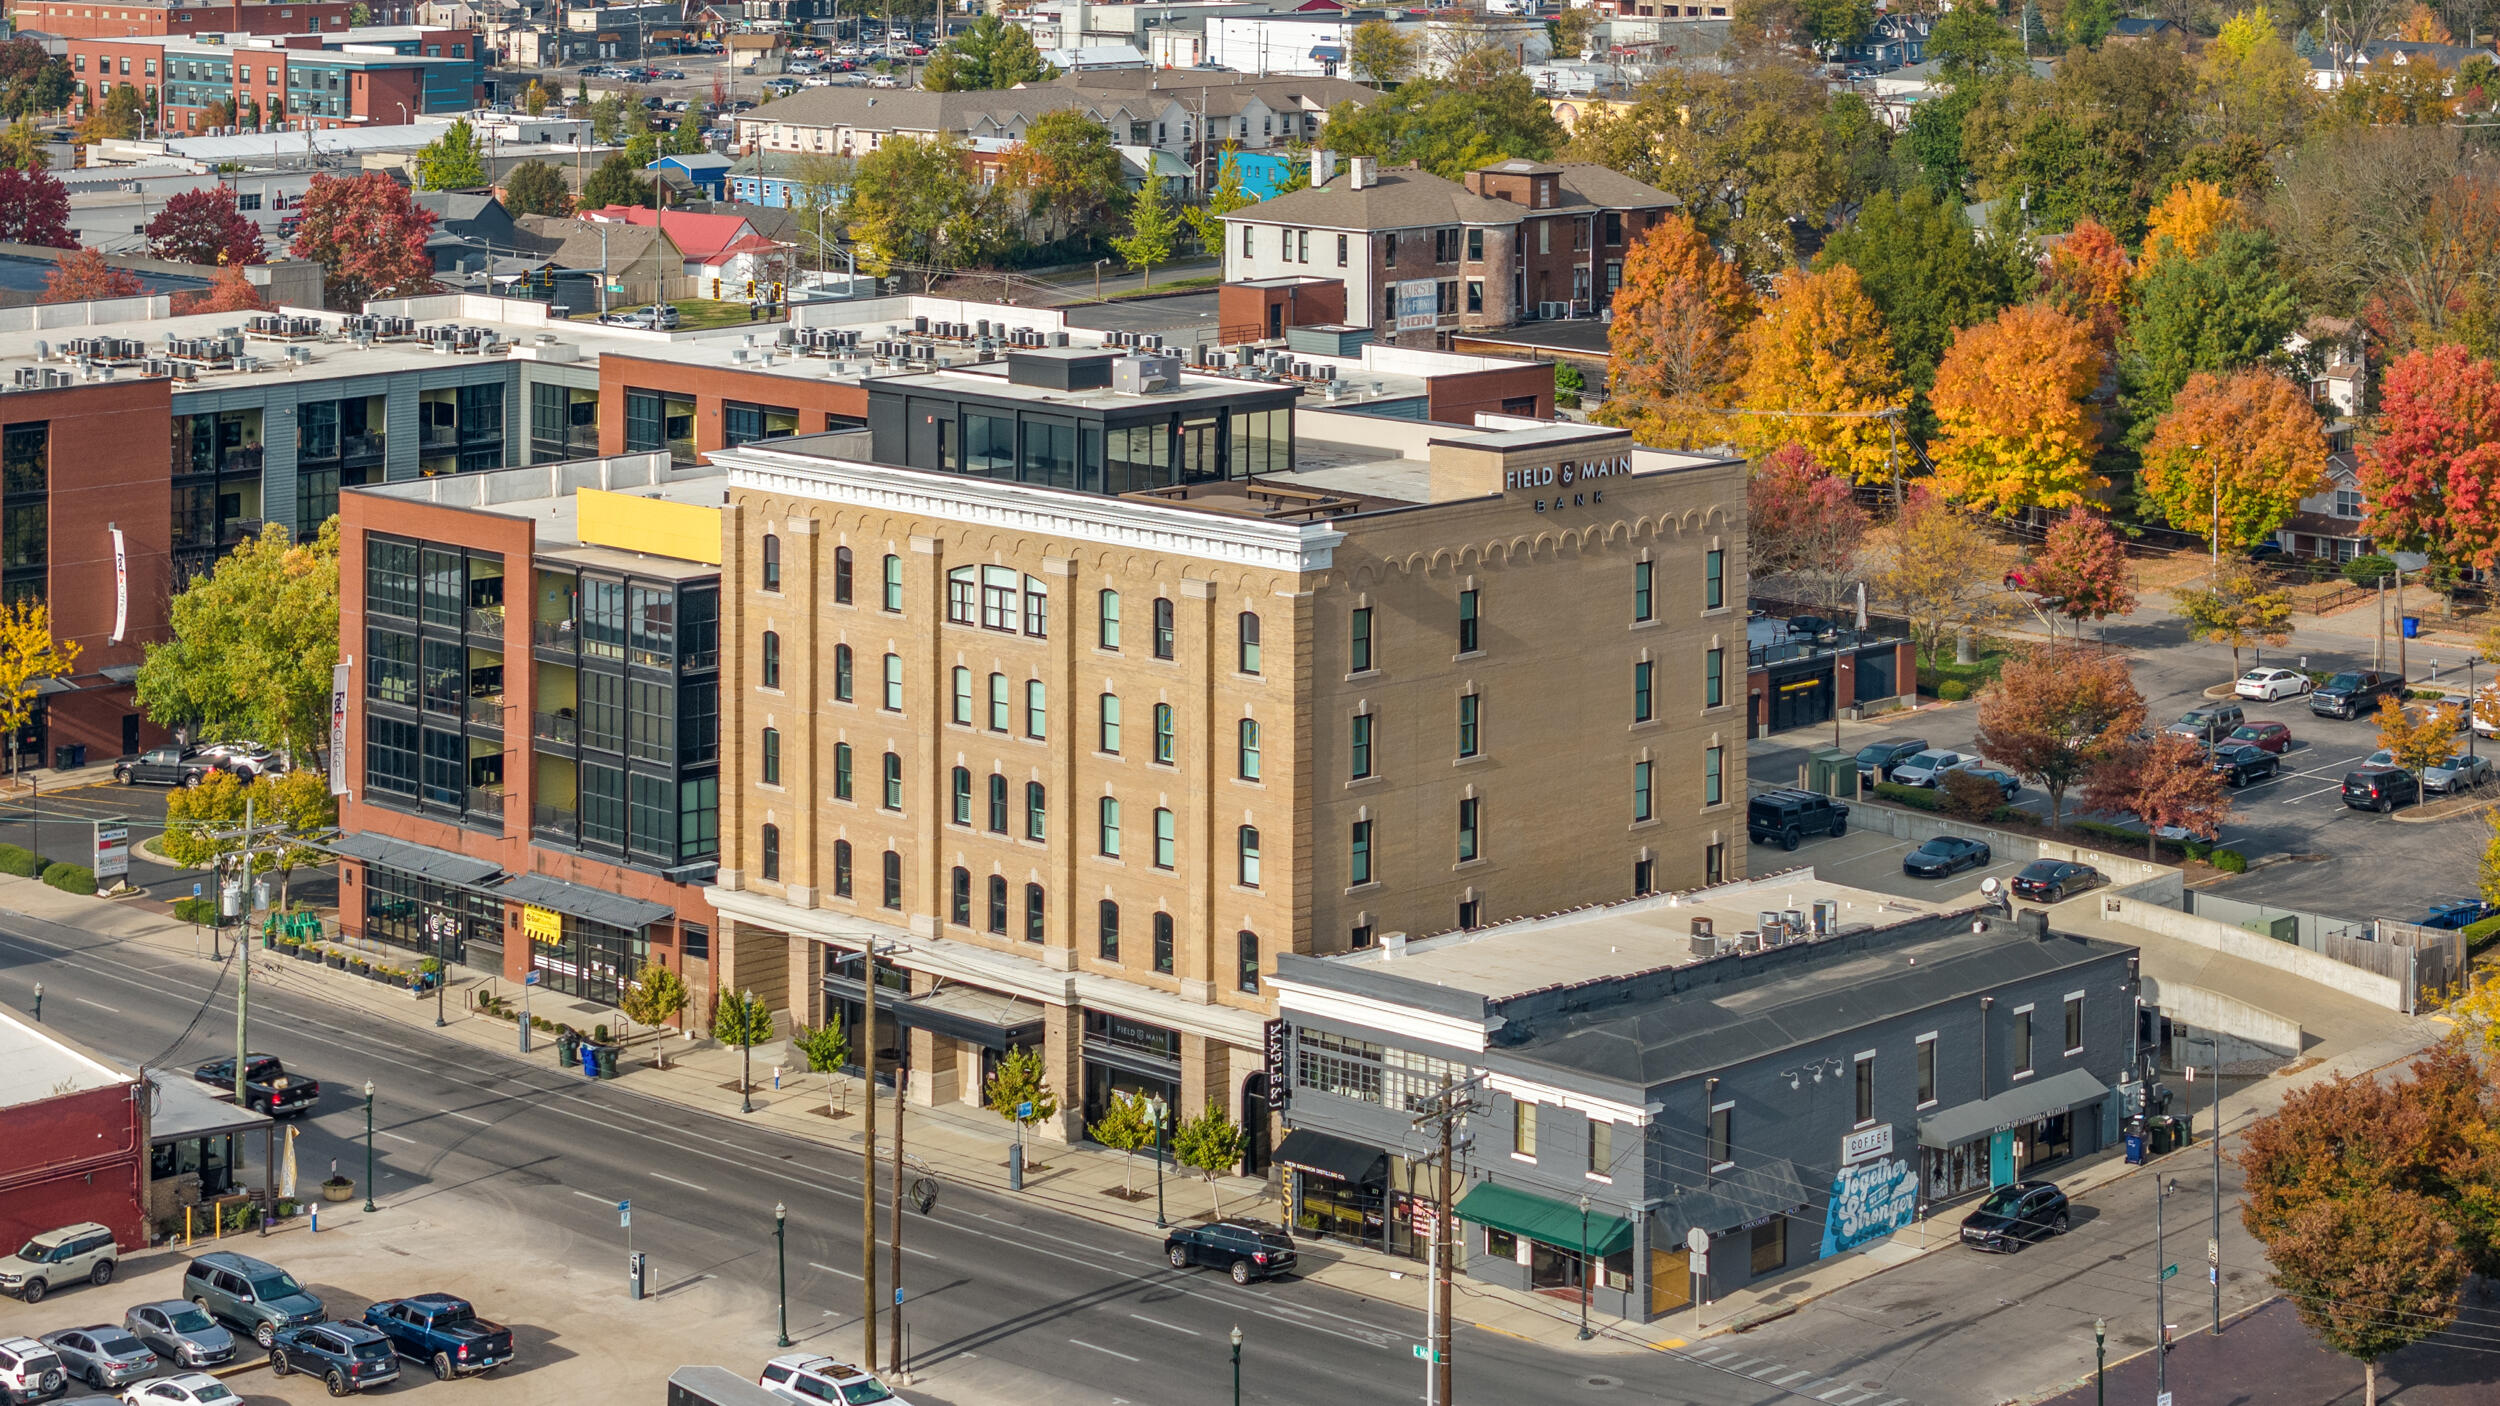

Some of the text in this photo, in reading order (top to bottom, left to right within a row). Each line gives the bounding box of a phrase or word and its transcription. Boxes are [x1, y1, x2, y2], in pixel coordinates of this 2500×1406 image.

[1506, 456, 1631, 490] FIELD & MAIN
[1536, 491, 1603, 513] BANK
[332, 691, 345, 768] FedEx Office
[2141, 864, 2153, 873] 50
[1116, 1025, 1136, 1037] FIELD
[1145, 1033, 1164, 1044] MAIN
[1270, 1023, 1282, 1085] MAPLE
[1270, 1087, 1282, 1099] &
[1851, 1131, 1888, 1151] COFFEE
[1837, 1157, 1908, 1204] Together
[1741, 1215, 1770, 1231] CHOCOLATE
[1838, 1194, 1914, 1237] Stronger
